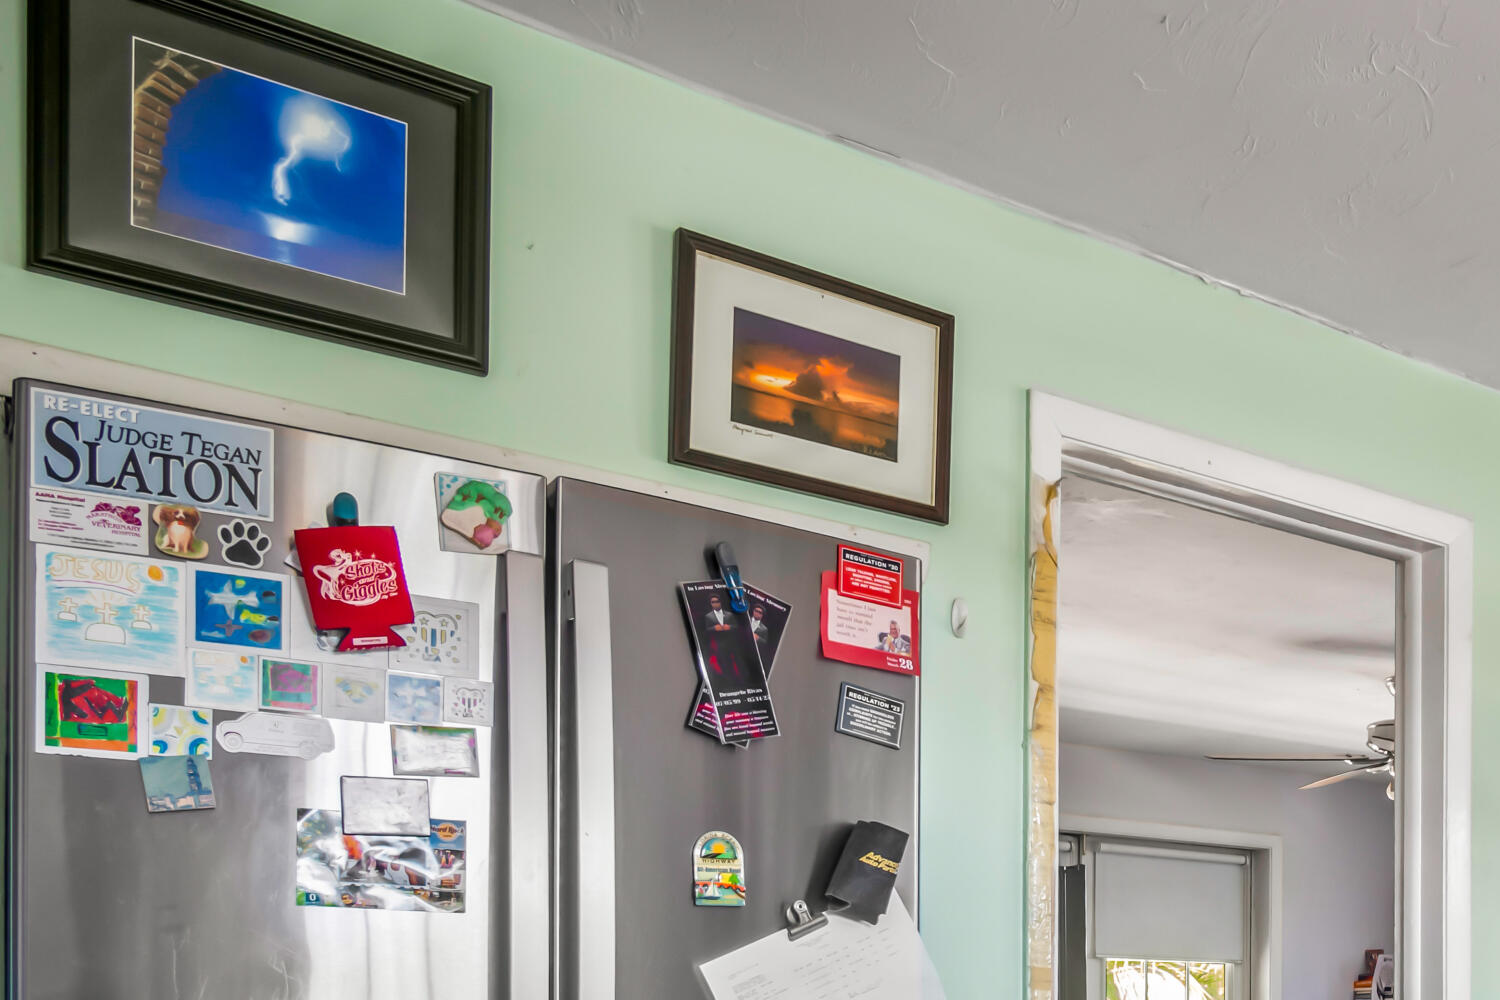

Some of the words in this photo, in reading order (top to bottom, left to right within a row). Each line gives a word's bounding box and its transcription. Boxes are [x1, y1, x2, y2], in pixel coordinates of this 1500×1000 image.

[43, 395, 141, 424] RE-ELECT
[94, 419, 174, 451] JUDGE
[181, 431, 262, 466] TEGAN
[44, 415, 262, 511] SLATON
[345, 562, 387, 579] Shots
[845, 553, 887, 568] REGULATION
[48, 554, 141, 594] JESUS
[341, 579, 398, 601] Giggles
[898, 657, 914, 670] 28
[848, 691, 890, 709] REGULATION
